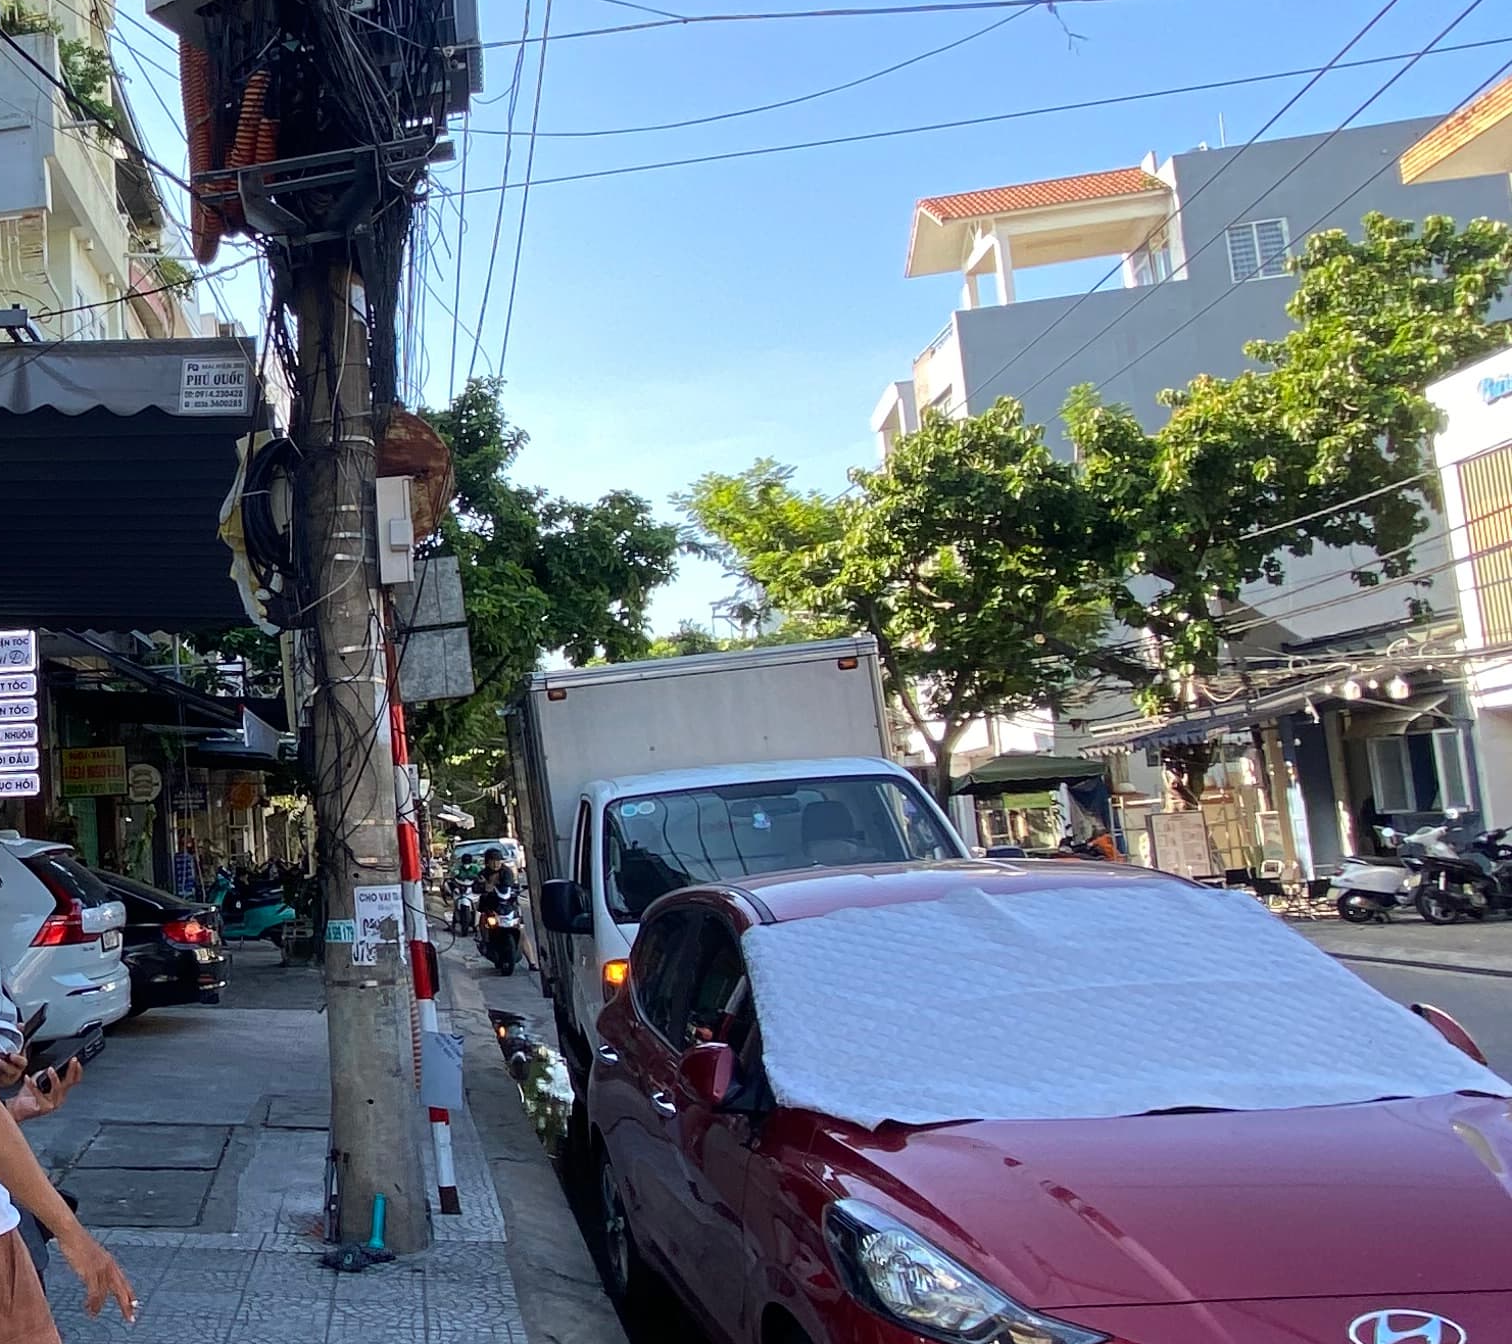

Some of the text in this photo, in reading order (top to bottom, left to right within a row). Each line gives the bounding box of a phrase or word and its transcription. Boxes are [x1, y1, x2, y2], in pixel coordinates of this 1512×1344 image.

[213, 370, 244, 386] QUỐC
[7, 680, 29, 691] TÓC
[8, 703, 29, 715] TÓC
[15, 779, 34, 790] HỒI
[359, 892, 378, 903] CHO
